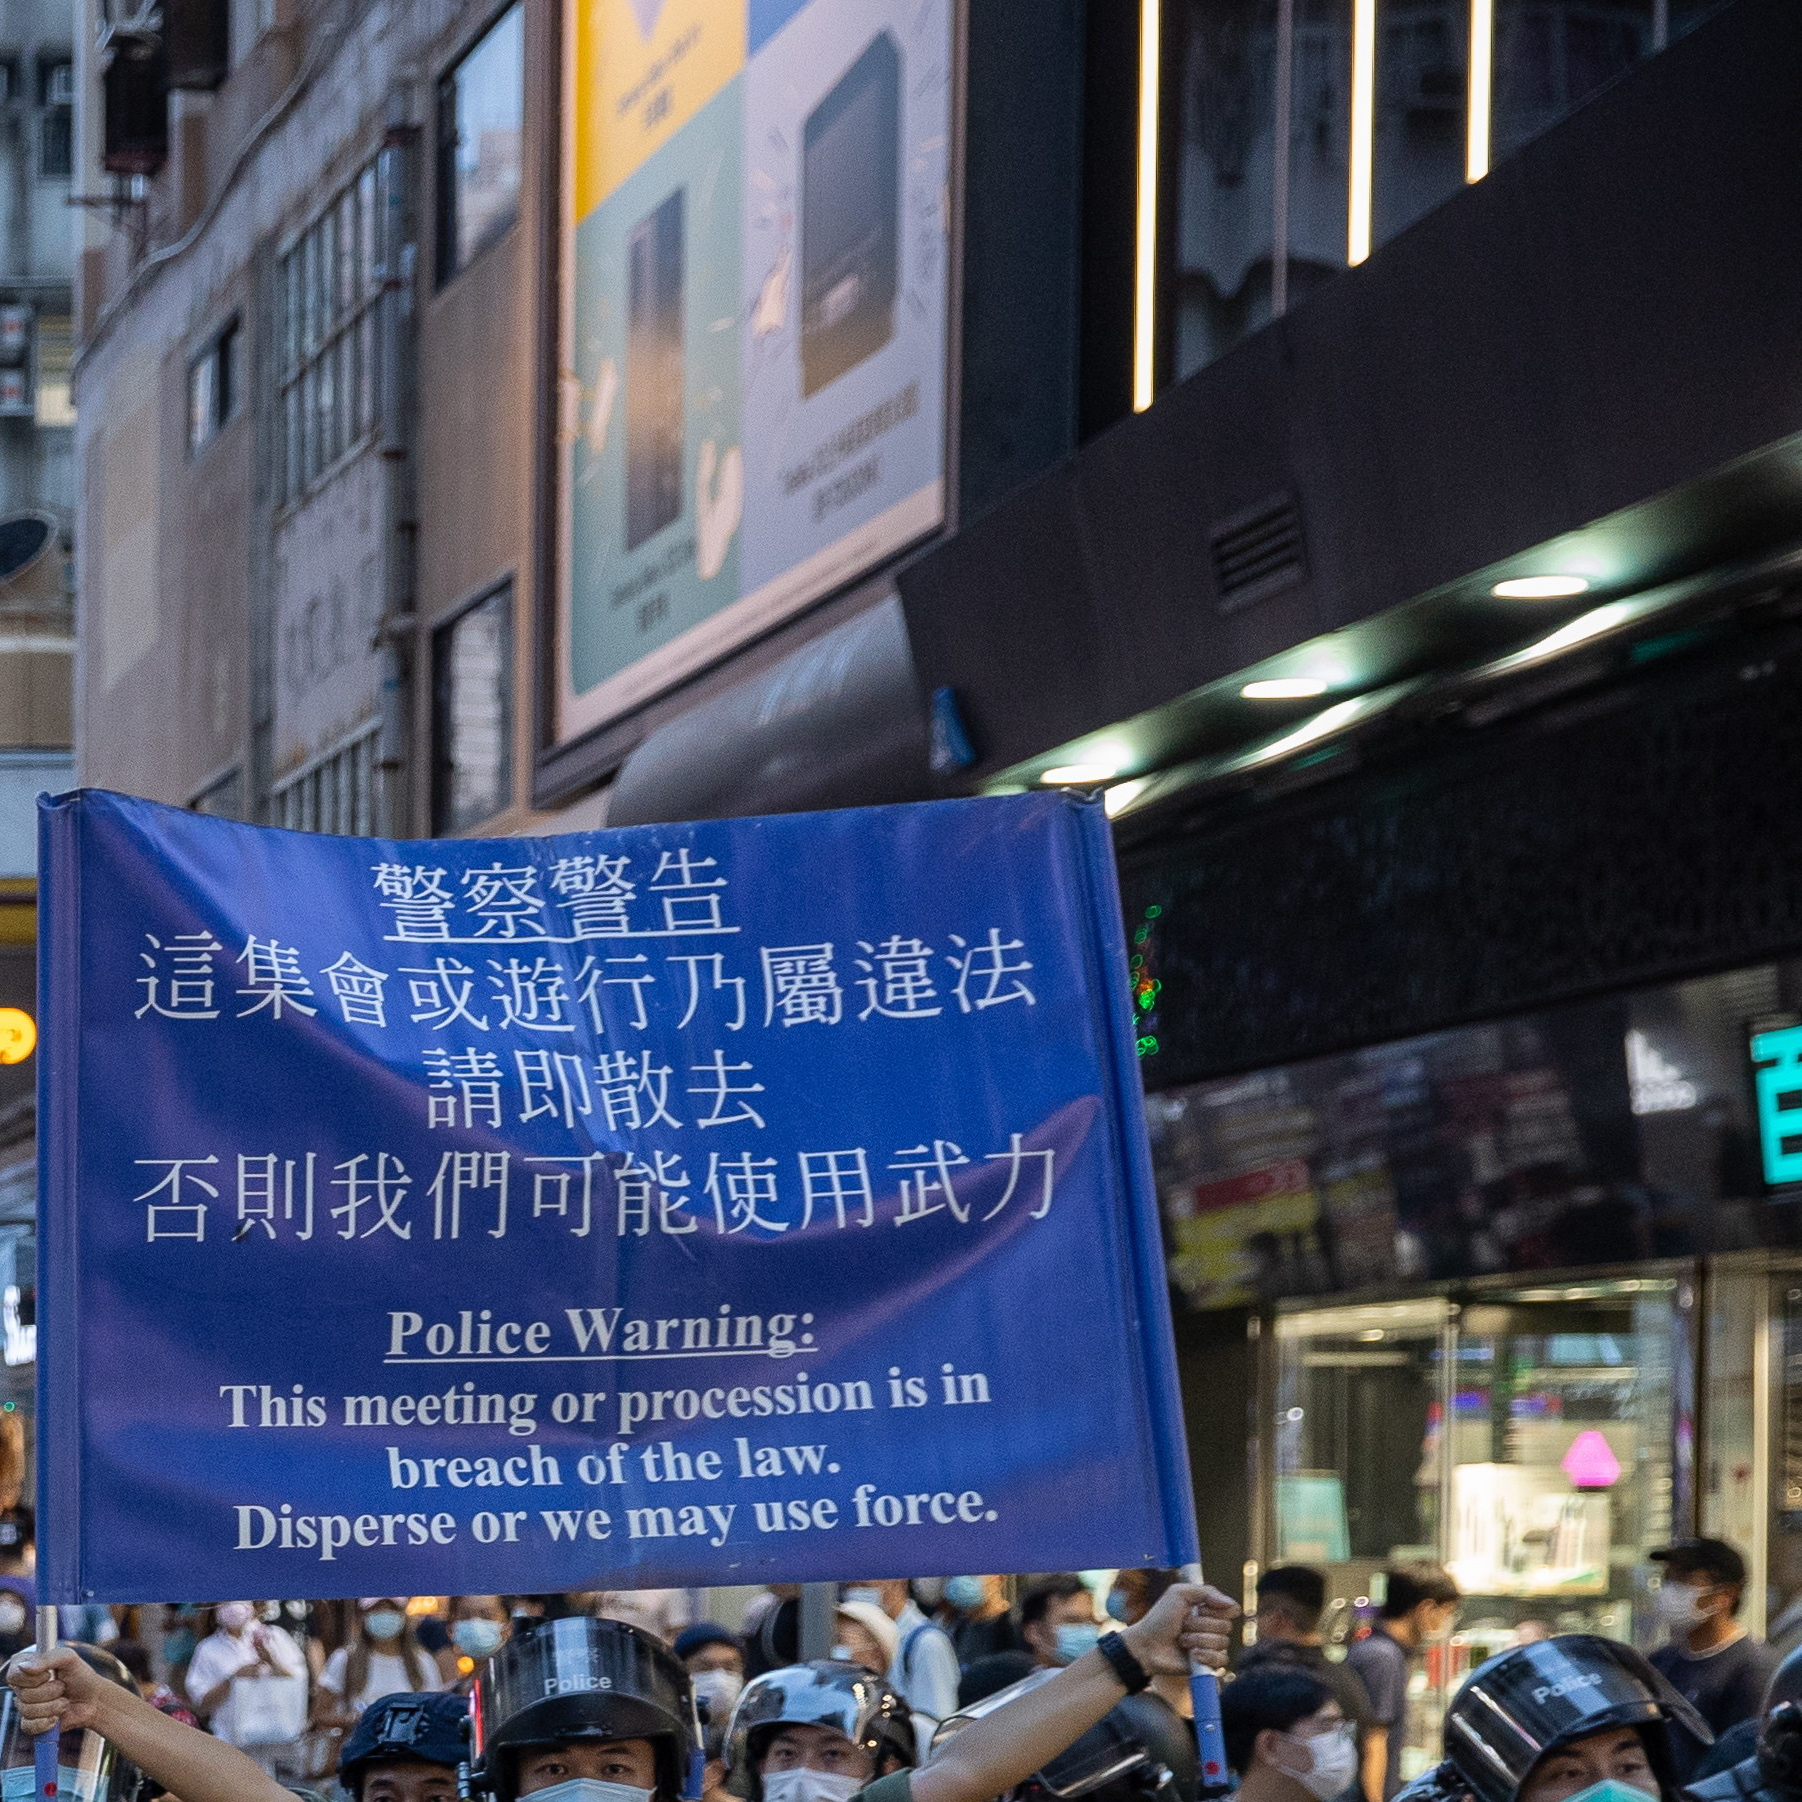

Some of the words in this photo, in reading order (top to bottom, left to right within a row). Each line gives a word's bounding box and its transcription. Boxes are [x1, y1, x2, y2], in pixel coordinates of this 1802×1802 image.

[372, 847, 729, 937] 警察警告
[134, 928, 1037, 1035] 這集會或遊行乃屬違法
[425, 1046, 767, 1132] 請即散去
[133, 1133, 1056, 1244] 否則我們可能使用武力
[385, 1309, 552, 1356] Police
[565, 1304, 815, 1358] Warning:
[219, 1384, 327, 1428] This
[343, 1382, 537, 1436] meeting
[551, 1389, 606, 1424] or
[617, 1372, 874, 1434] procession
[888, 1366, 928, 1409] is
[941, 1363, 992, 1405] in
[385, 1445, 562, 1489] breach
[577, 1443, 631, 1485] of
[640, 1441, 723, 1483] the
[734, 1437, 841, 1478] law.
[233, 1503, 456, 1560] Disperse
[471, 1509, 527, 1544] or
[539, 1508, 612, 1542] we
[625, 1503, 737, 1547] may
[752, 1498, 839, 1533] use
[851, 1484, 998, 1529] force.
[544, 1674, 613, 1696] Police
[1531, 1673, 1603, 1705] Police
